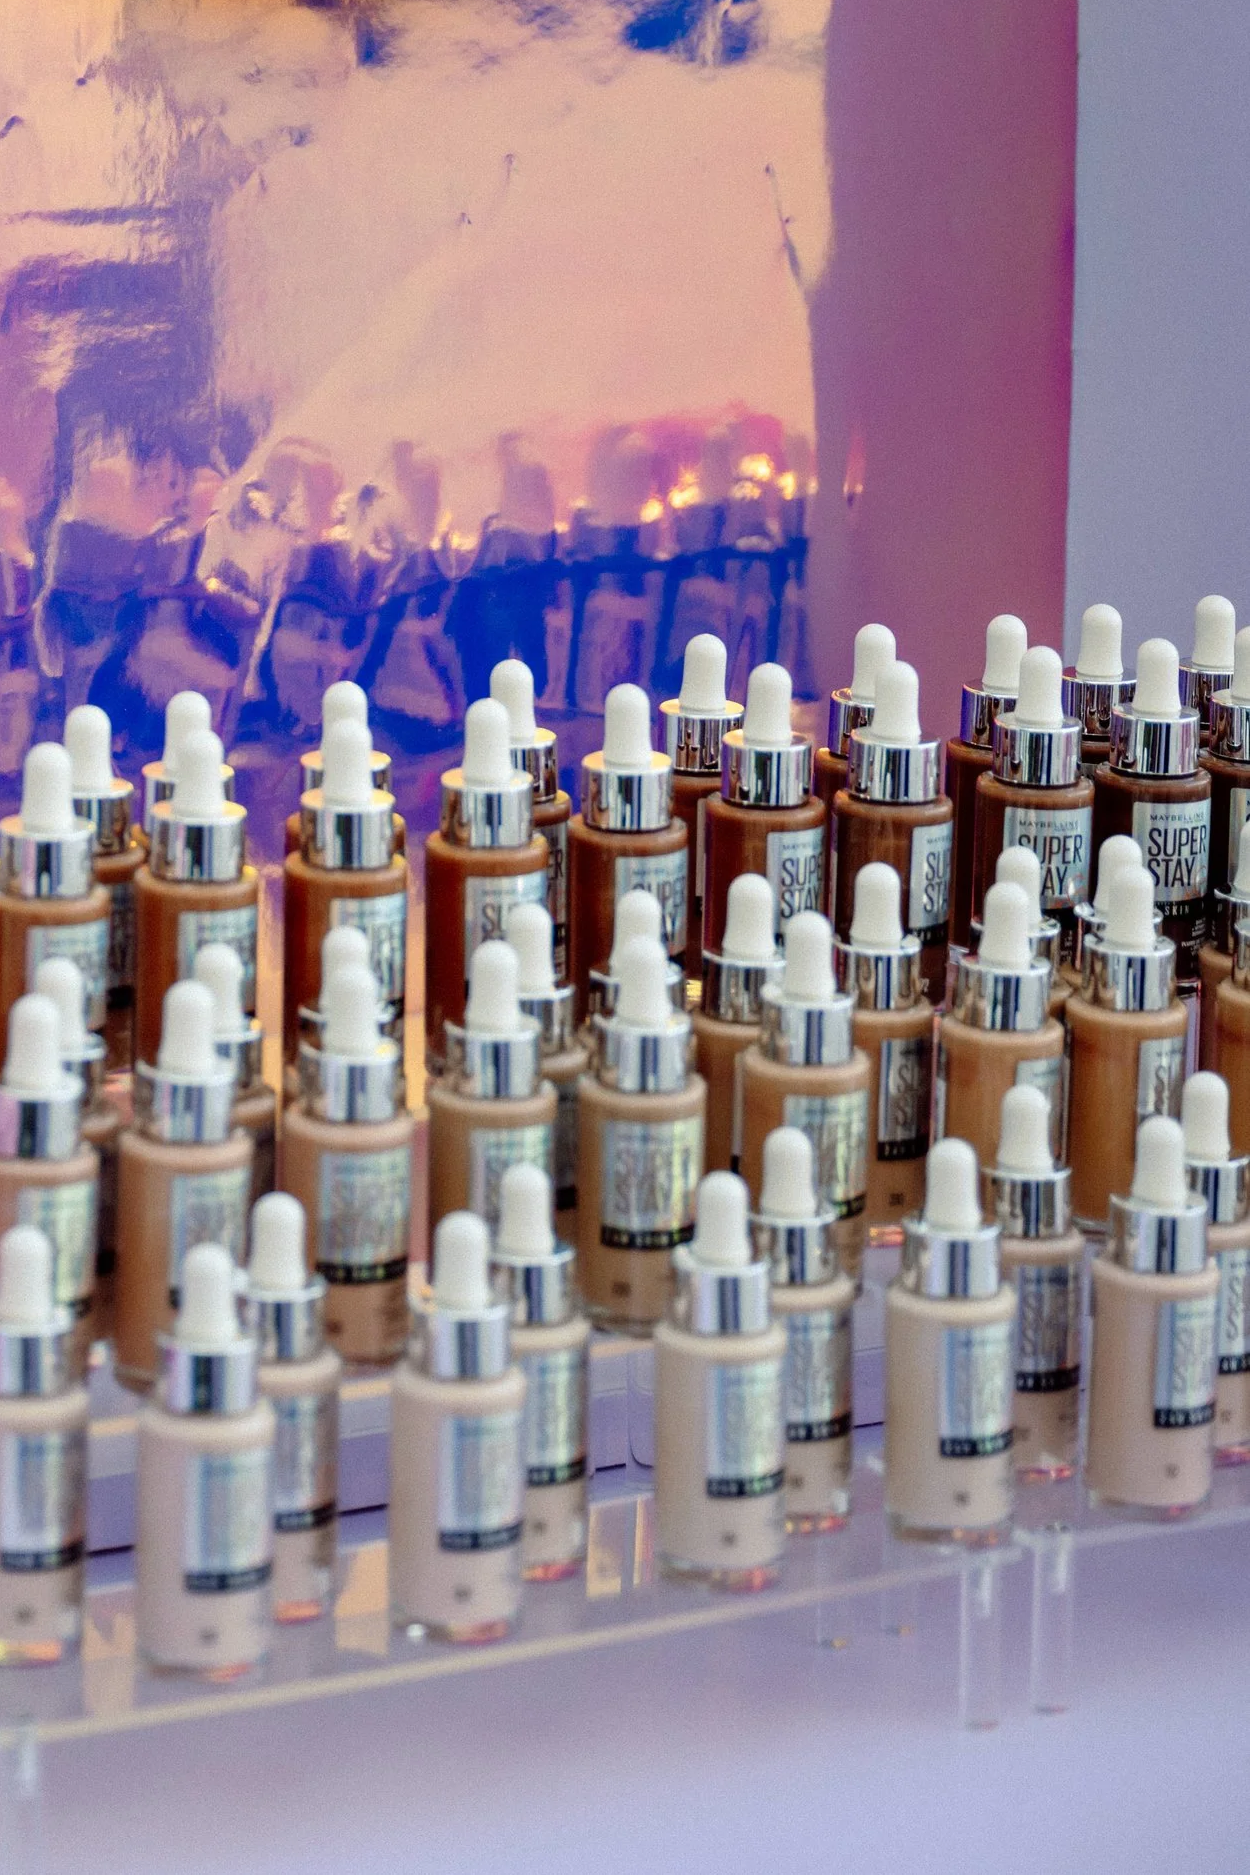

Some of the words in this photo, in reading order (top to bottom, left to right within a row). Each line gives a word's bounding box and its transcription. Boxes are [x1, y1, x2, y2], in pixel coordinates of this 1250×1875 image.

[1147, 824, 1207, 857] SUPER
[781, 851, 823, 887] SUPE
[1040, 866, 1068, 896] AY
[1147, 856, 1196, 888] STAY
